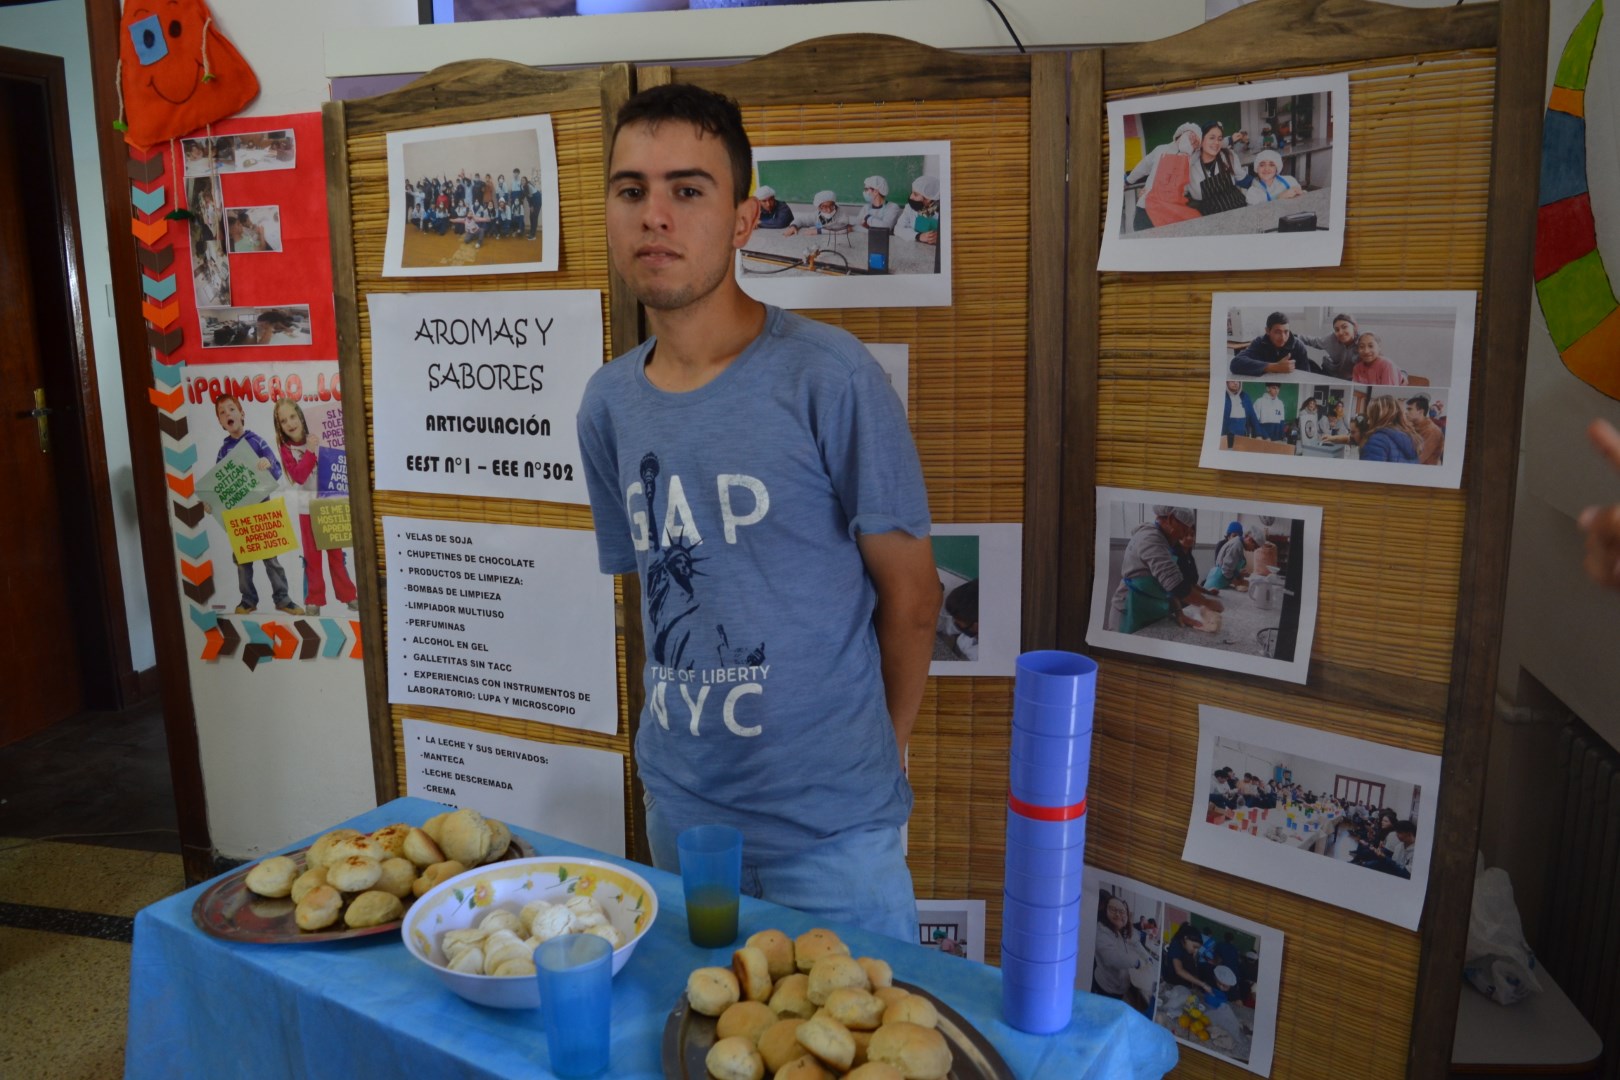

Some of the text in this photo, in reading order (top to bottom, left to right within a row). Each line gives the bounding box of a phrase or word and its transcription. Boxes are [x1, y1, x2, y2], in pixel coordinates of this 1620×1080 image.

[414, 318, 553, 347] AROMAS Y
[428, 363, 544, 393] SABORES
[327, 410, 336, 419] SI
[322, 419, 344, 429] TOLE
[426, 414, 551, 436] ARTICULACIÓN
[216, 460, 235, 480] SI ME
[407, 455, 439, 472] EEST
[492, 460, 518, 477] EEE
[219, 470, 254, 503] APRENDO A
[328, 481, 334, 489] A
[331, 472, 348, 483] APR
[230, 510, 282, 528] SI ME TRATAN
[317, 514, 351, 524] HOSTILI
[320, 506, 329, 515] SI
[331, 505, 343, 514] ME
[627, 473, 770, 550] GAP
[234, 527, 249, 536] CON
[246, 531, 278, 544] APRENDO
[405, 532, 473, 545] VELAS DE SOJA
[240, 538, 289, 554] A SER JUSTO.
[407, 550, 535, 568] CHUPETINES DE CHOCOLATE
[409, 567, 523, 585] PRODUCTOS DE LIMPIEZA:
[446, 588, 457, 596] DE
[460, 589, 501, 601] LIMPIEZA
[458, 606, 504, 618] MULTIUSO
[413, 636, 488, 652] ALCOHOL EN GEL
[413, 653, 512, 672] GALLETITAS SIN TACC
[678, 669, 695, 682] OF
[702, 665, 770, 684] LIBERTY
[414, 671, 590, 702] EXPERIENCIAS CON INSTRUMENTOS DE
[408, 685, 575, 715] LABORATORIO: LUPA Y MICROSCOPIO
[650, 681, 762, 737] NYC
[426, 736, 548, 764] LA LECHE Y SUS DERIVADOS:
[455, 773, 513, 791] DESCREMADA
